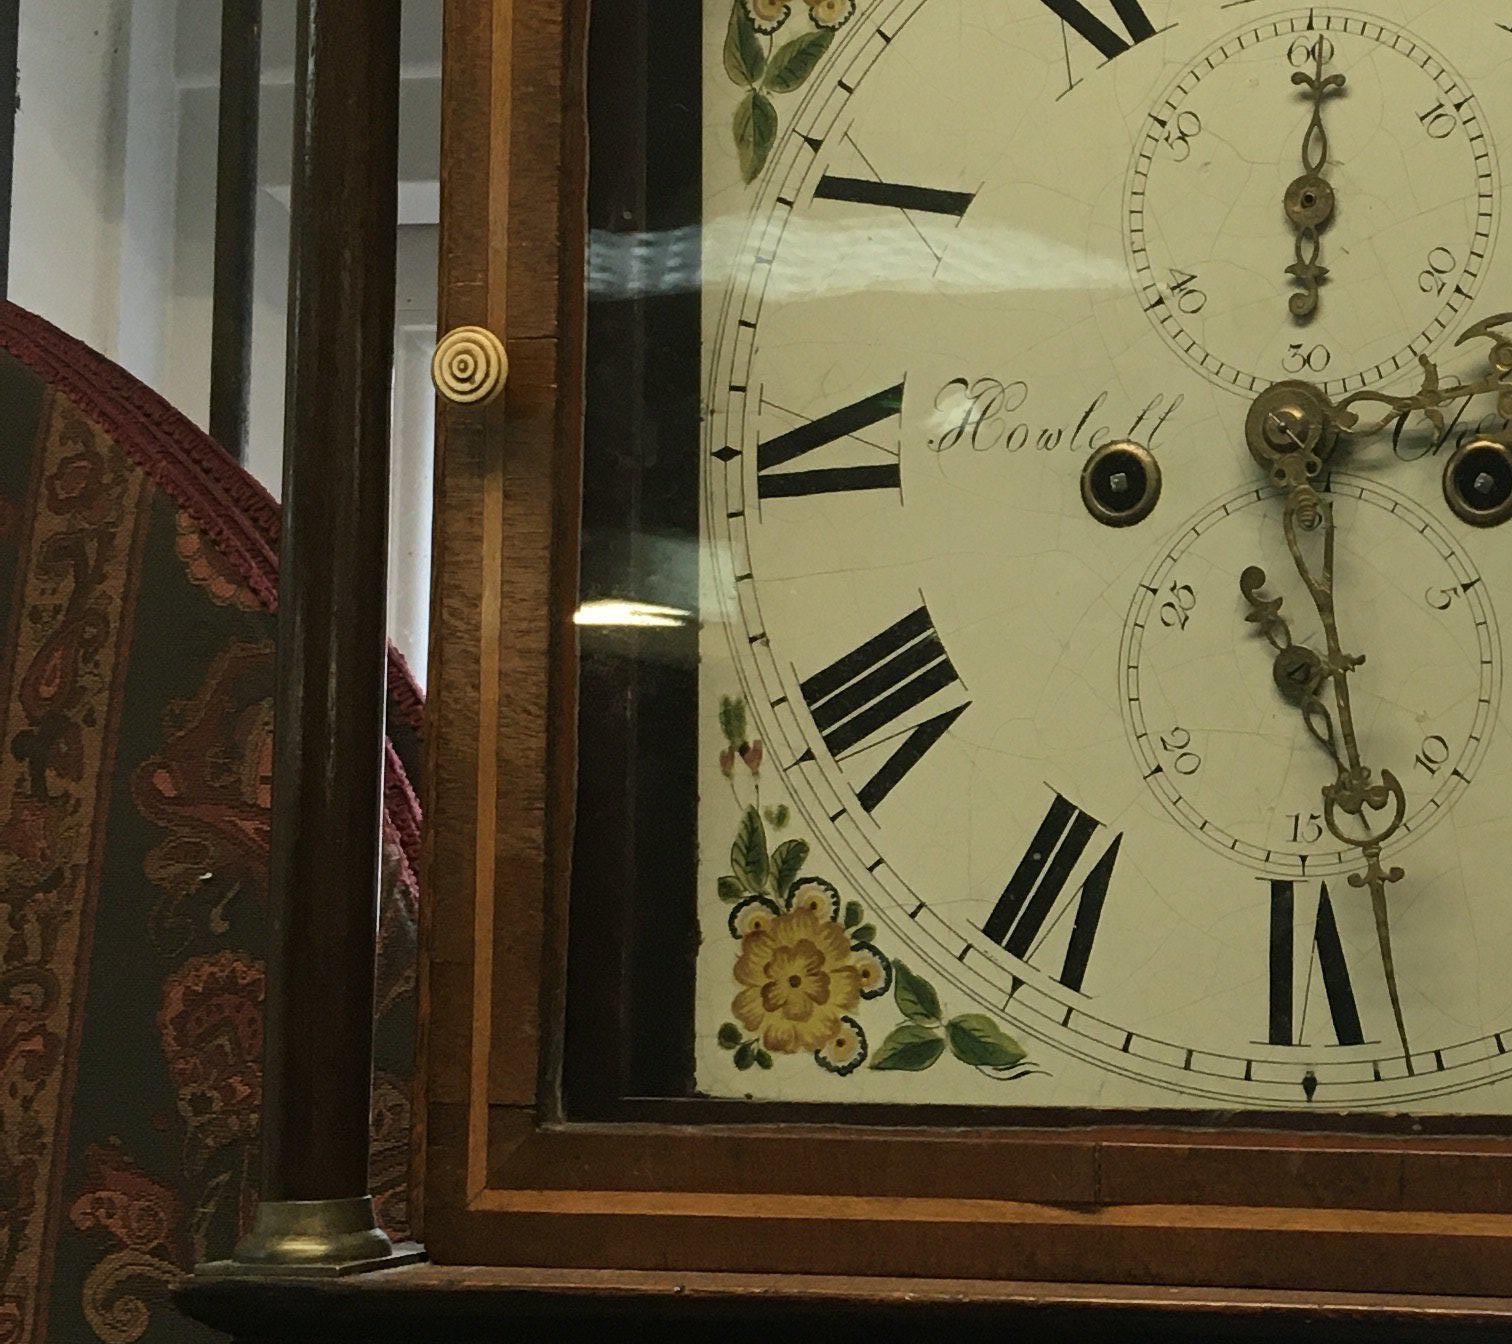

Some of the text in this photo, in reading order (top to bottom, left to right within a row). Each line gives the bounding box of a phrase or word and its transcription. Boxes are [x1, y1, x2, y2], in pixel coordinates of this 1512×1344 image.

[1286, 35, 1335, 68] 60
[1164, 109, 1203, 164] 50
[1416, 99, 1457, 141] 10
[811, 119, 985, 278] X
[1166, 267, 1208, 316] 40
[1417, 244, 1457, 298] 20
[1281, 342, 1332, 373] 30
[756, 371, 908, 524] IX
[1158, 579, 1199, 632] 25
[1424, 584, 1458, 613] 5
[790, 587, 973, 829] VIII
[1159, 725, 1202, 776] 20
[1412, 734, 1451, 776] 10
[1286, 812, 1323, 843] 15
[966, 781, 1124, 1000] VII
[1250, 876, 1382, 1048] VI
